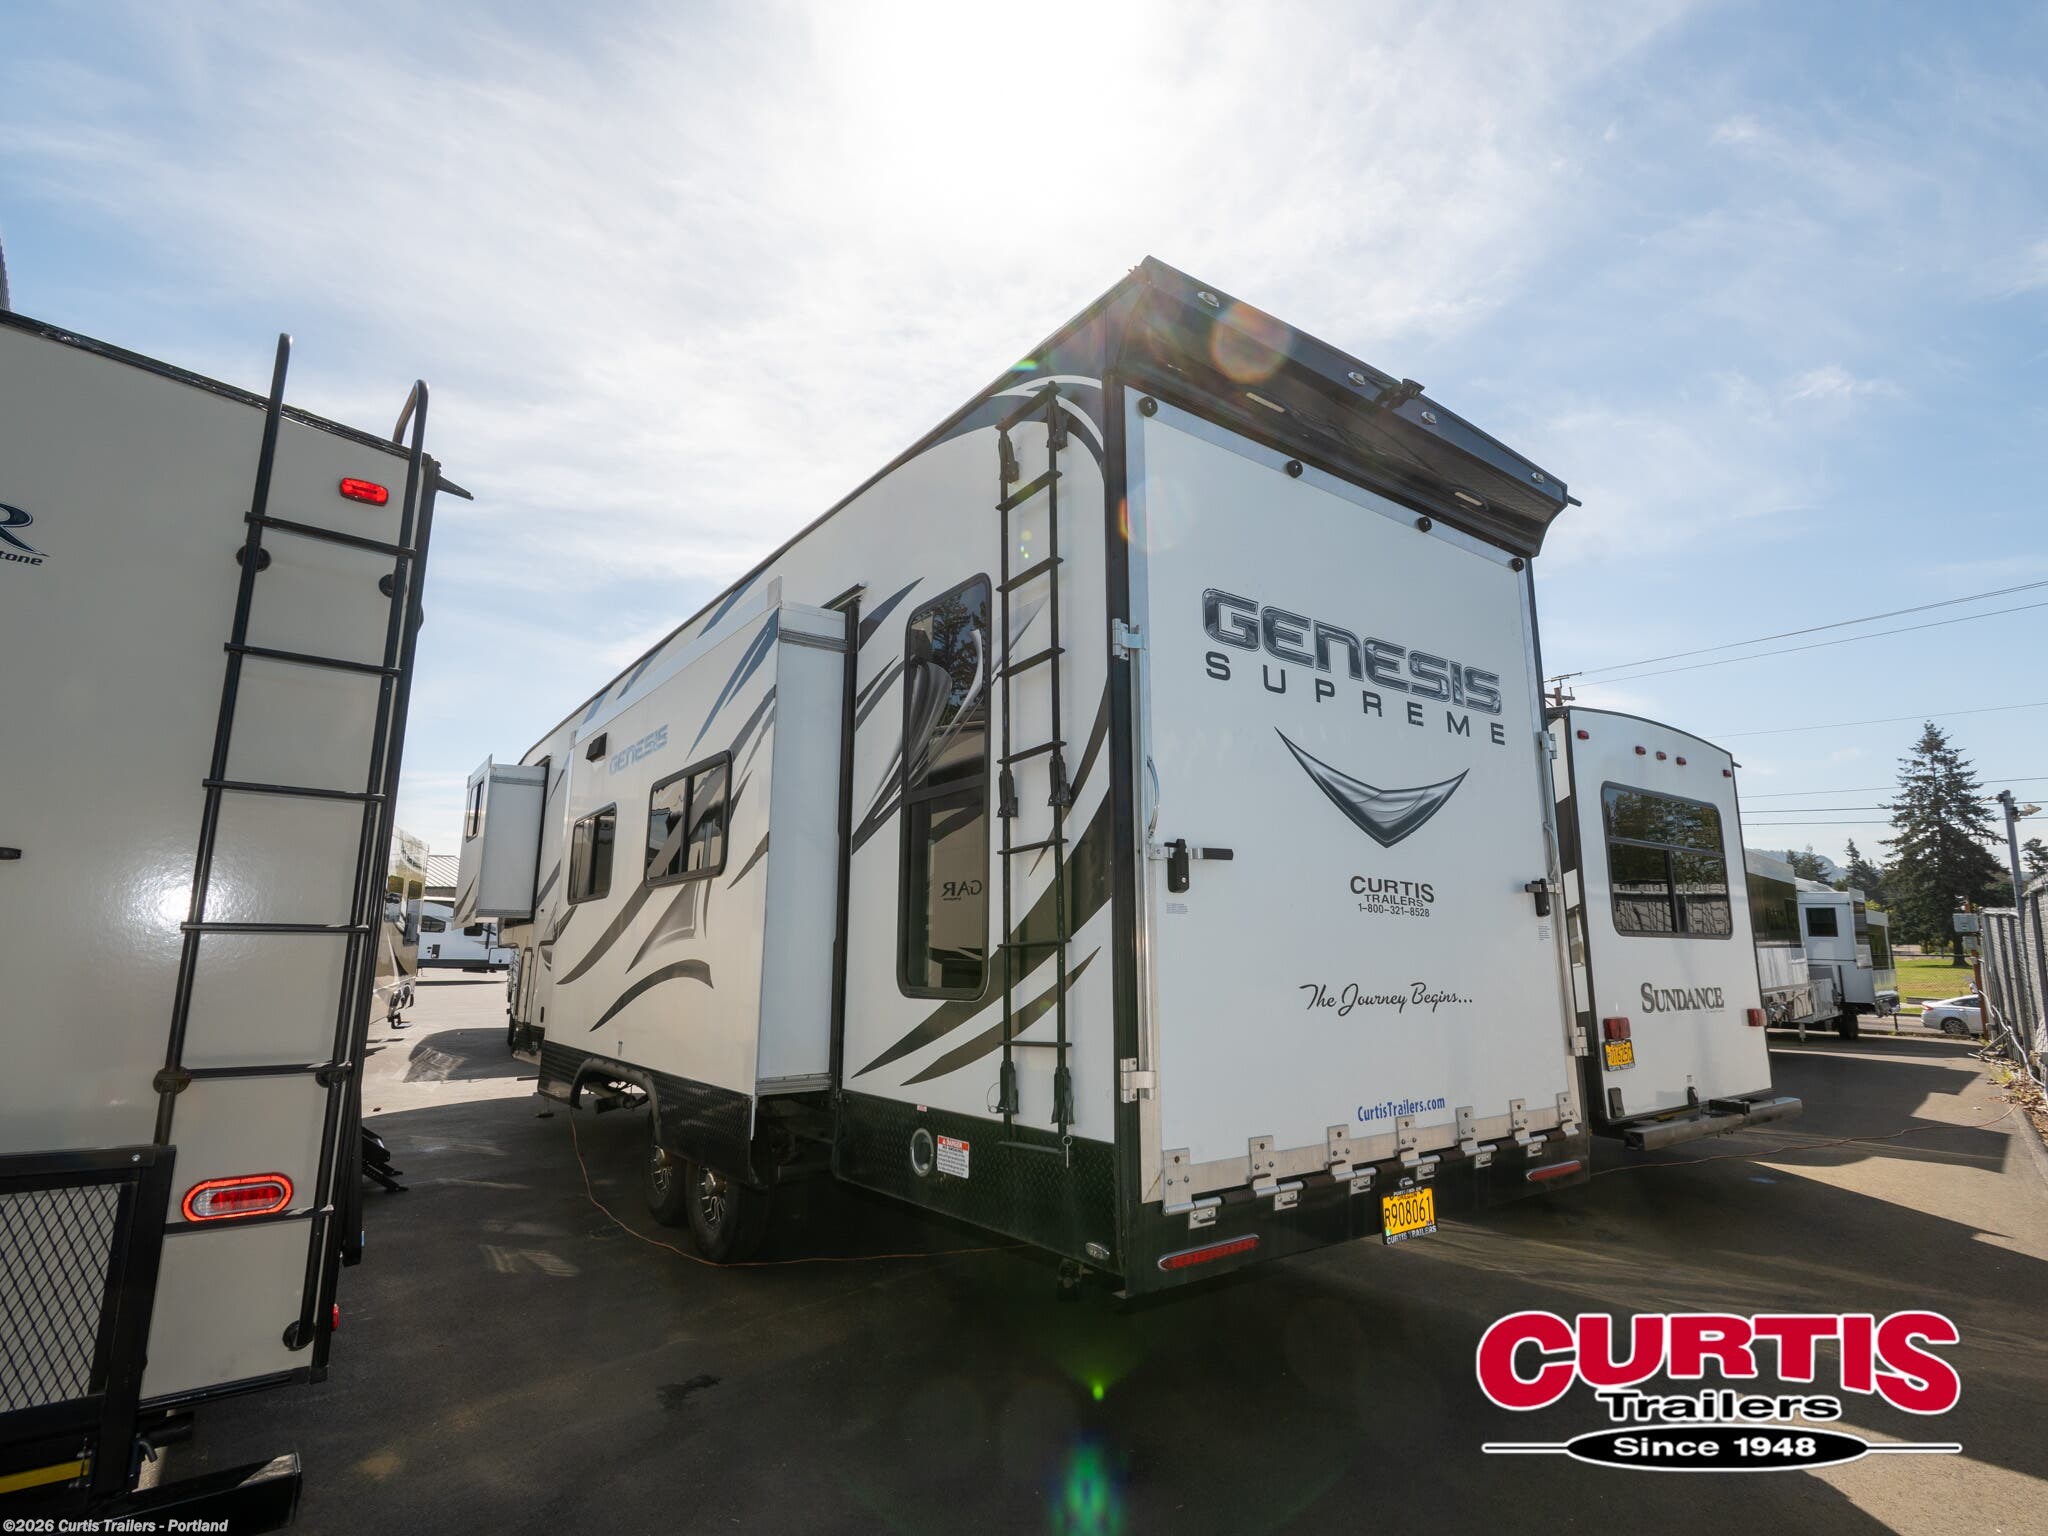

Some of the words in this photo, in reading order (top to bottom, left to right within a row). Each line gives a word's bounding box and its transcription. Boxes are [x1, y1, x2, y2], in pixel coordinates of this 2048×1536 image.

[1202, 588, 1502, 716] GENESIS
[1205, 651, 1506, 746] SUPREME
[609, 724, 668, 776] GENESIS
[1350, 876, 1434, 903] CURTIS
[1364, 894, 1424, 908] TRAILERS
[1358, 903, 1430, 917] 1-800-321-8528
[1299, 984, 1337, 1010] The
[1338, 983, 1407, 1016] Journey
[1411, 982, 1472, 1012] Begins...
[1358, 1097, 1445, 1122] CurtisTrailers.com
[1384, 1196, 1432, 1228] R908061
[1386, 1231, 1408, 1245] CURTIS
[1409, 1225, 1437, 1239] TRAILERS
